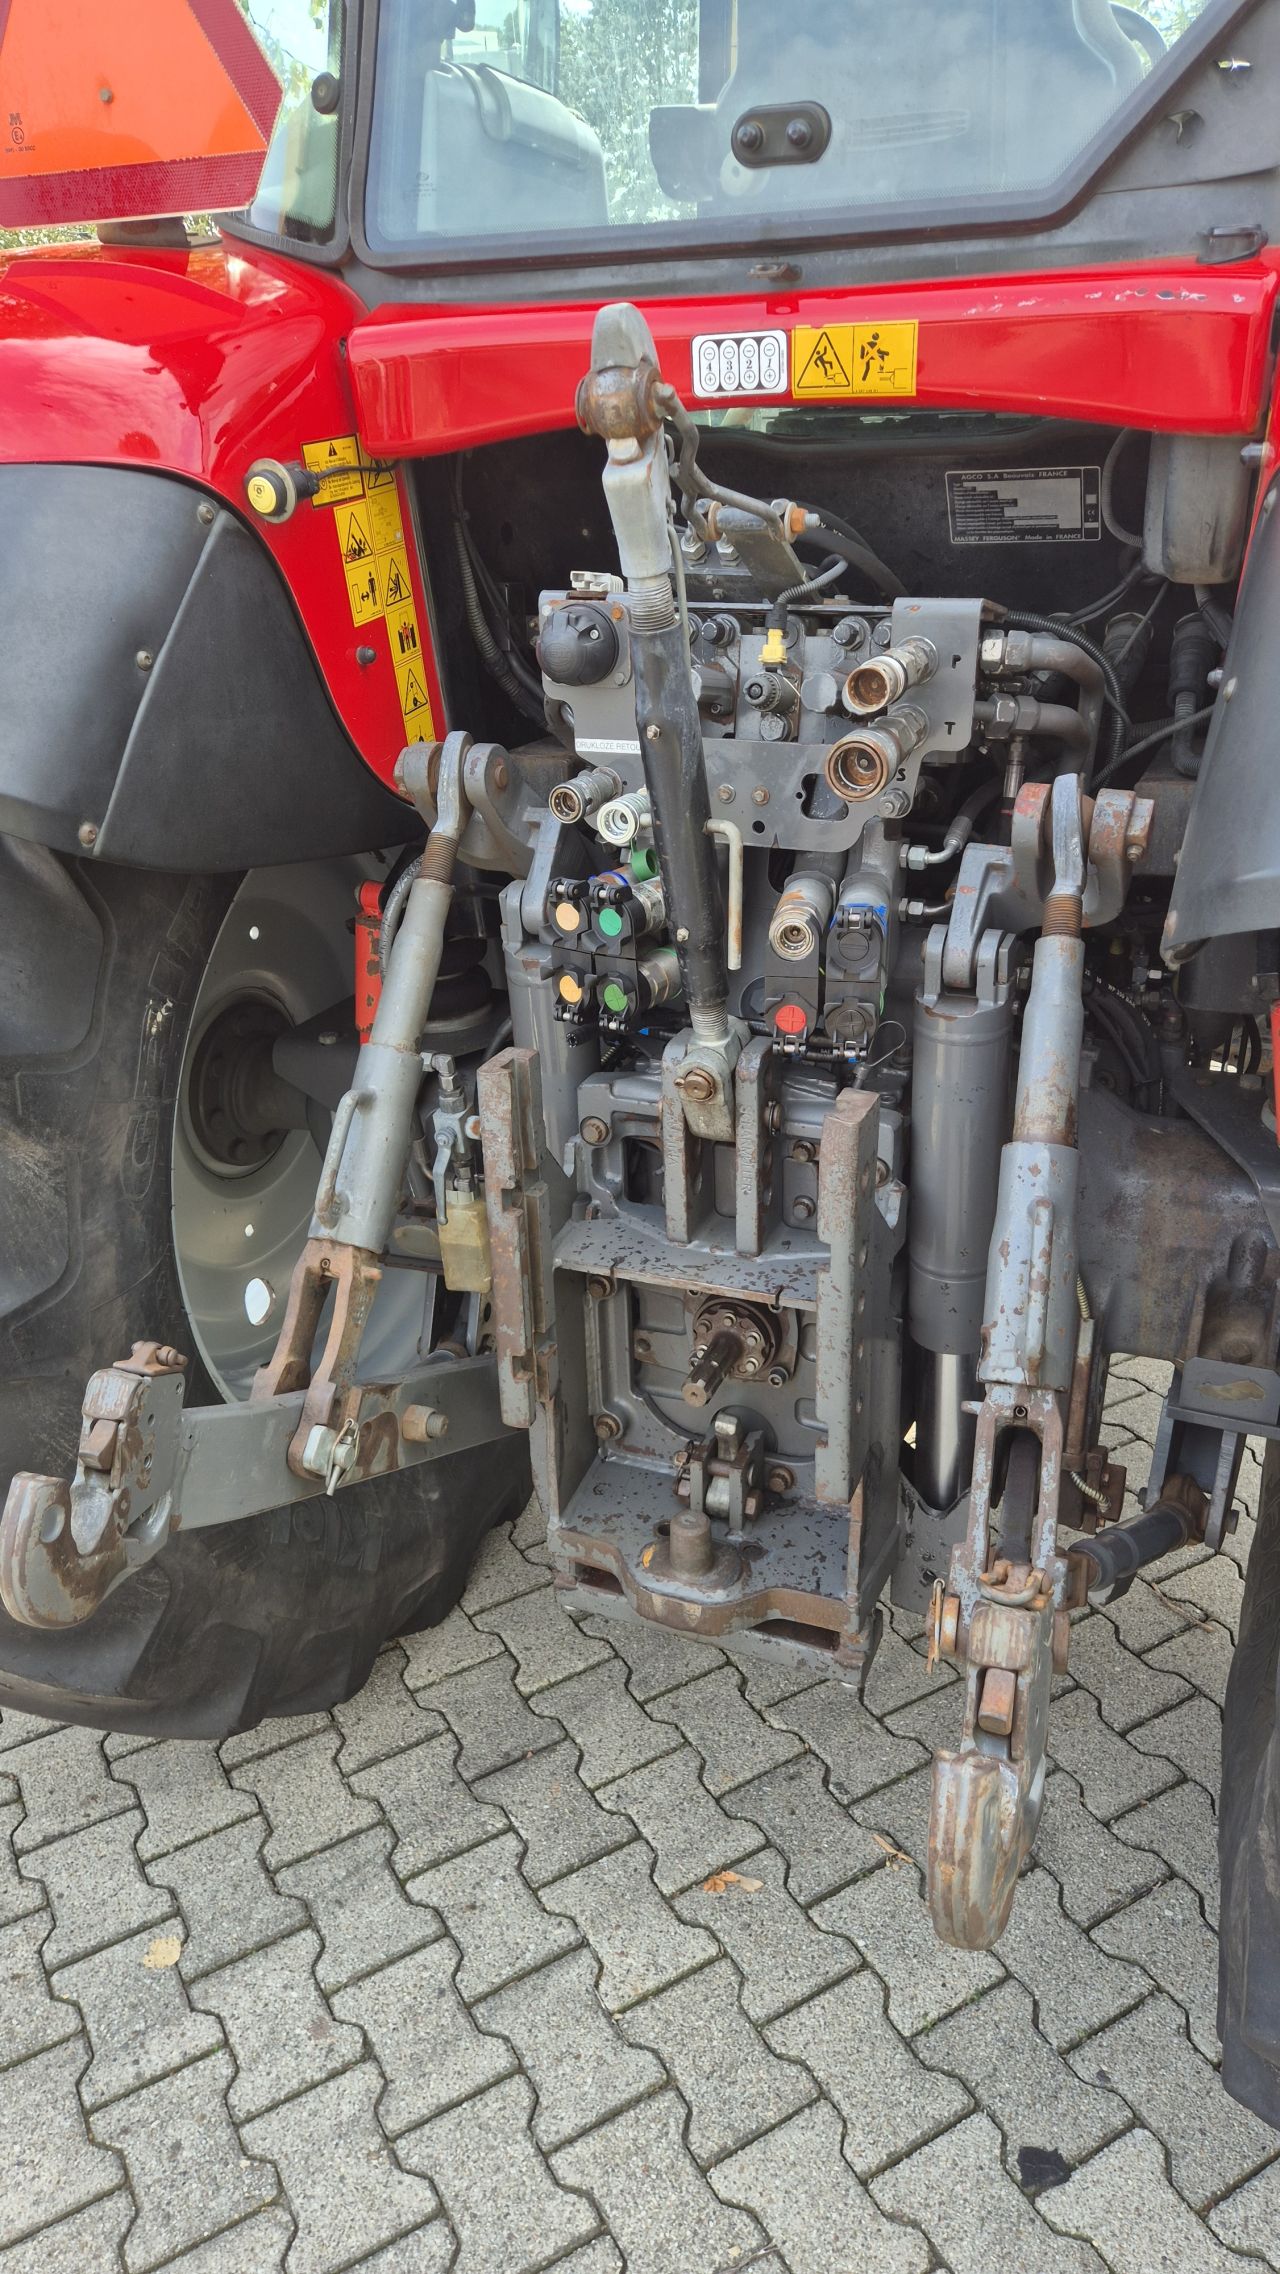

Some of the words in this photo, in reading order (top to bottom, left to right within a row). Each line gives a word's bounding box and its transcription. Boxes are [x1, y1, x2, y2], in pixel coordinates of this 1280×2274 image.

[706, 362, 712, 371] 4
[726, 361, 733, 370] 3
[746, 360, 753, 369] 2
[951, 654, 962, 669] P
[944, 721, 956, 735] T
[896, 768, 906, 782] S
